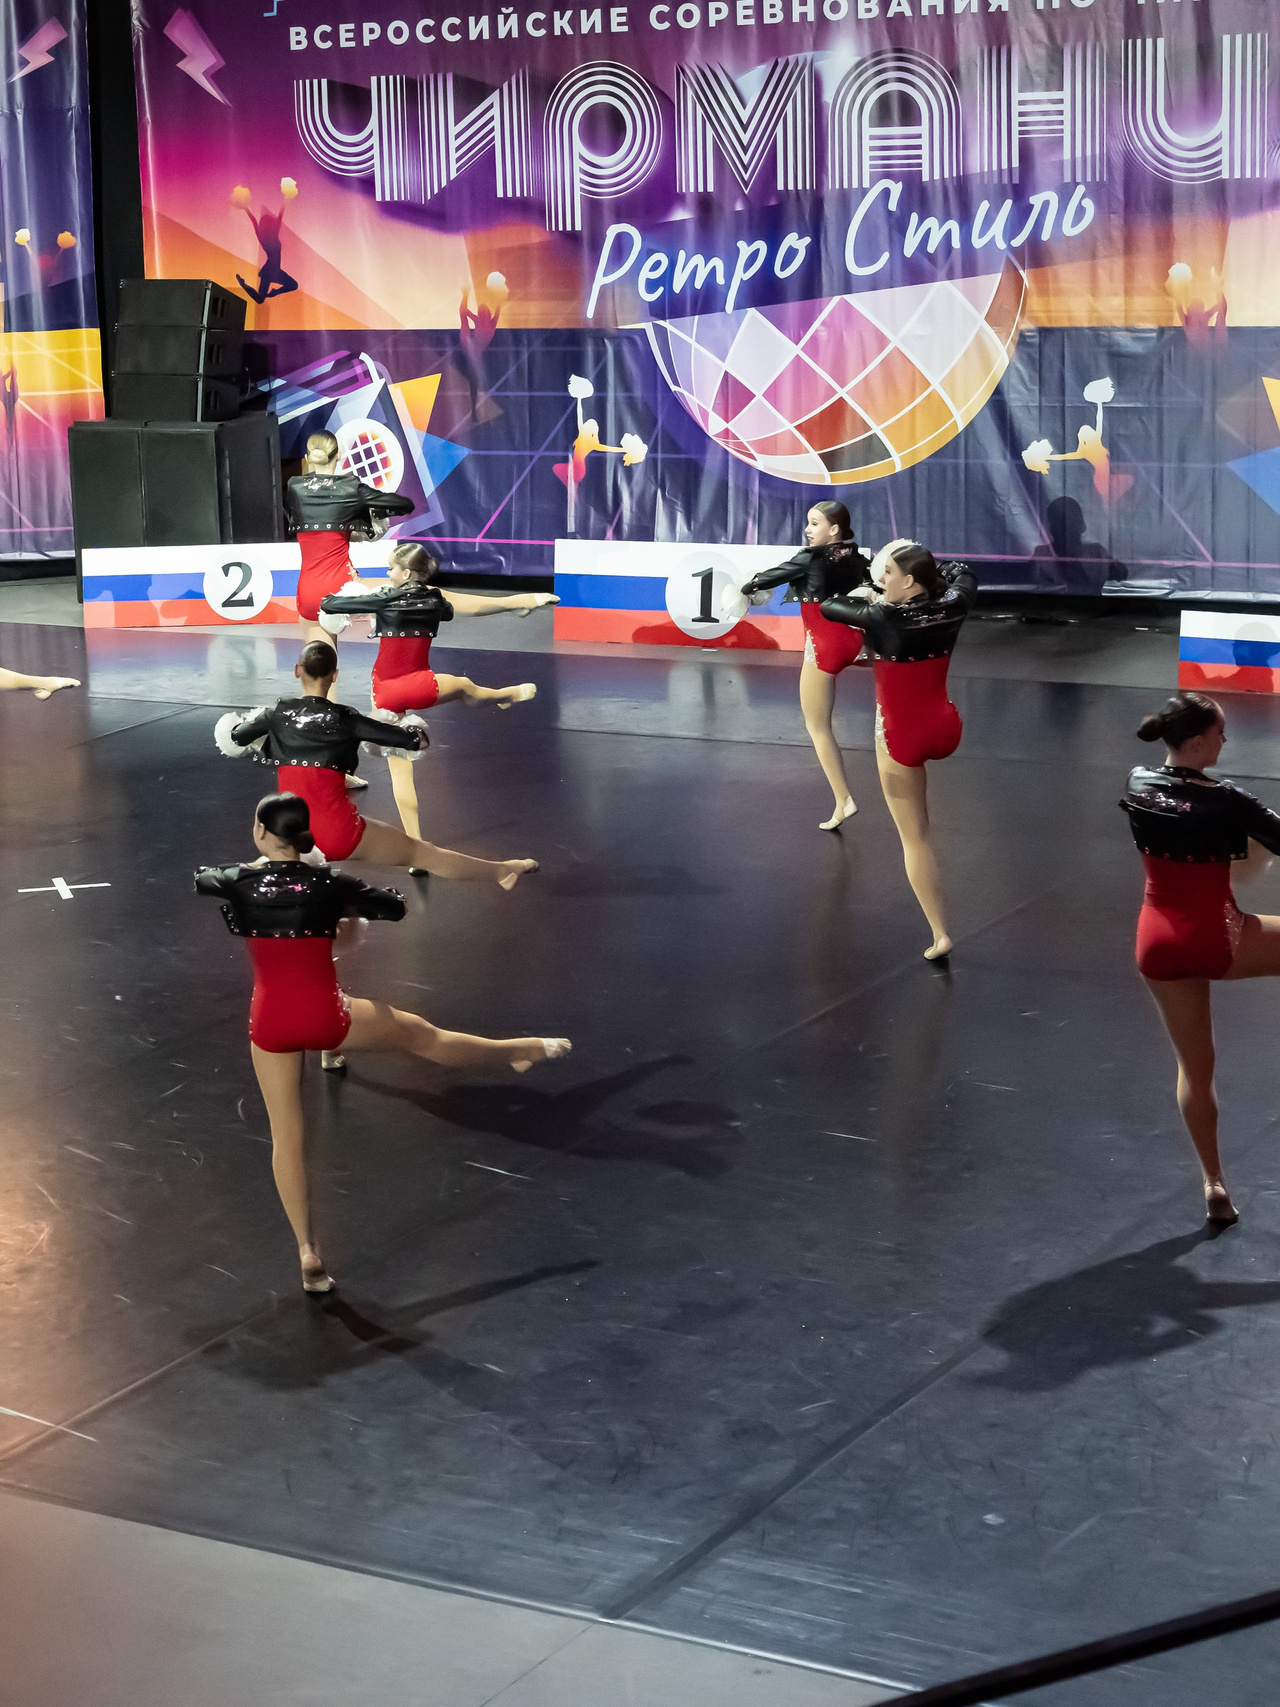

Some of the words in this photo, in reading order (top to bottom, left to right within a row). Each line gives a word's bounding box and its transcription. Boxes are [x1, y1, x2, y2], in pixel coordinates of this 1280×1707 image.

[289, 7, 629, 51] ВСЕРОССИЙСКИЕ
[585, 222, 812, 320] Ретро
[844, 177, 1095, 277] Стиль
[221, 560, 255, 609] 2
[691, 566, 721, 624] 1
